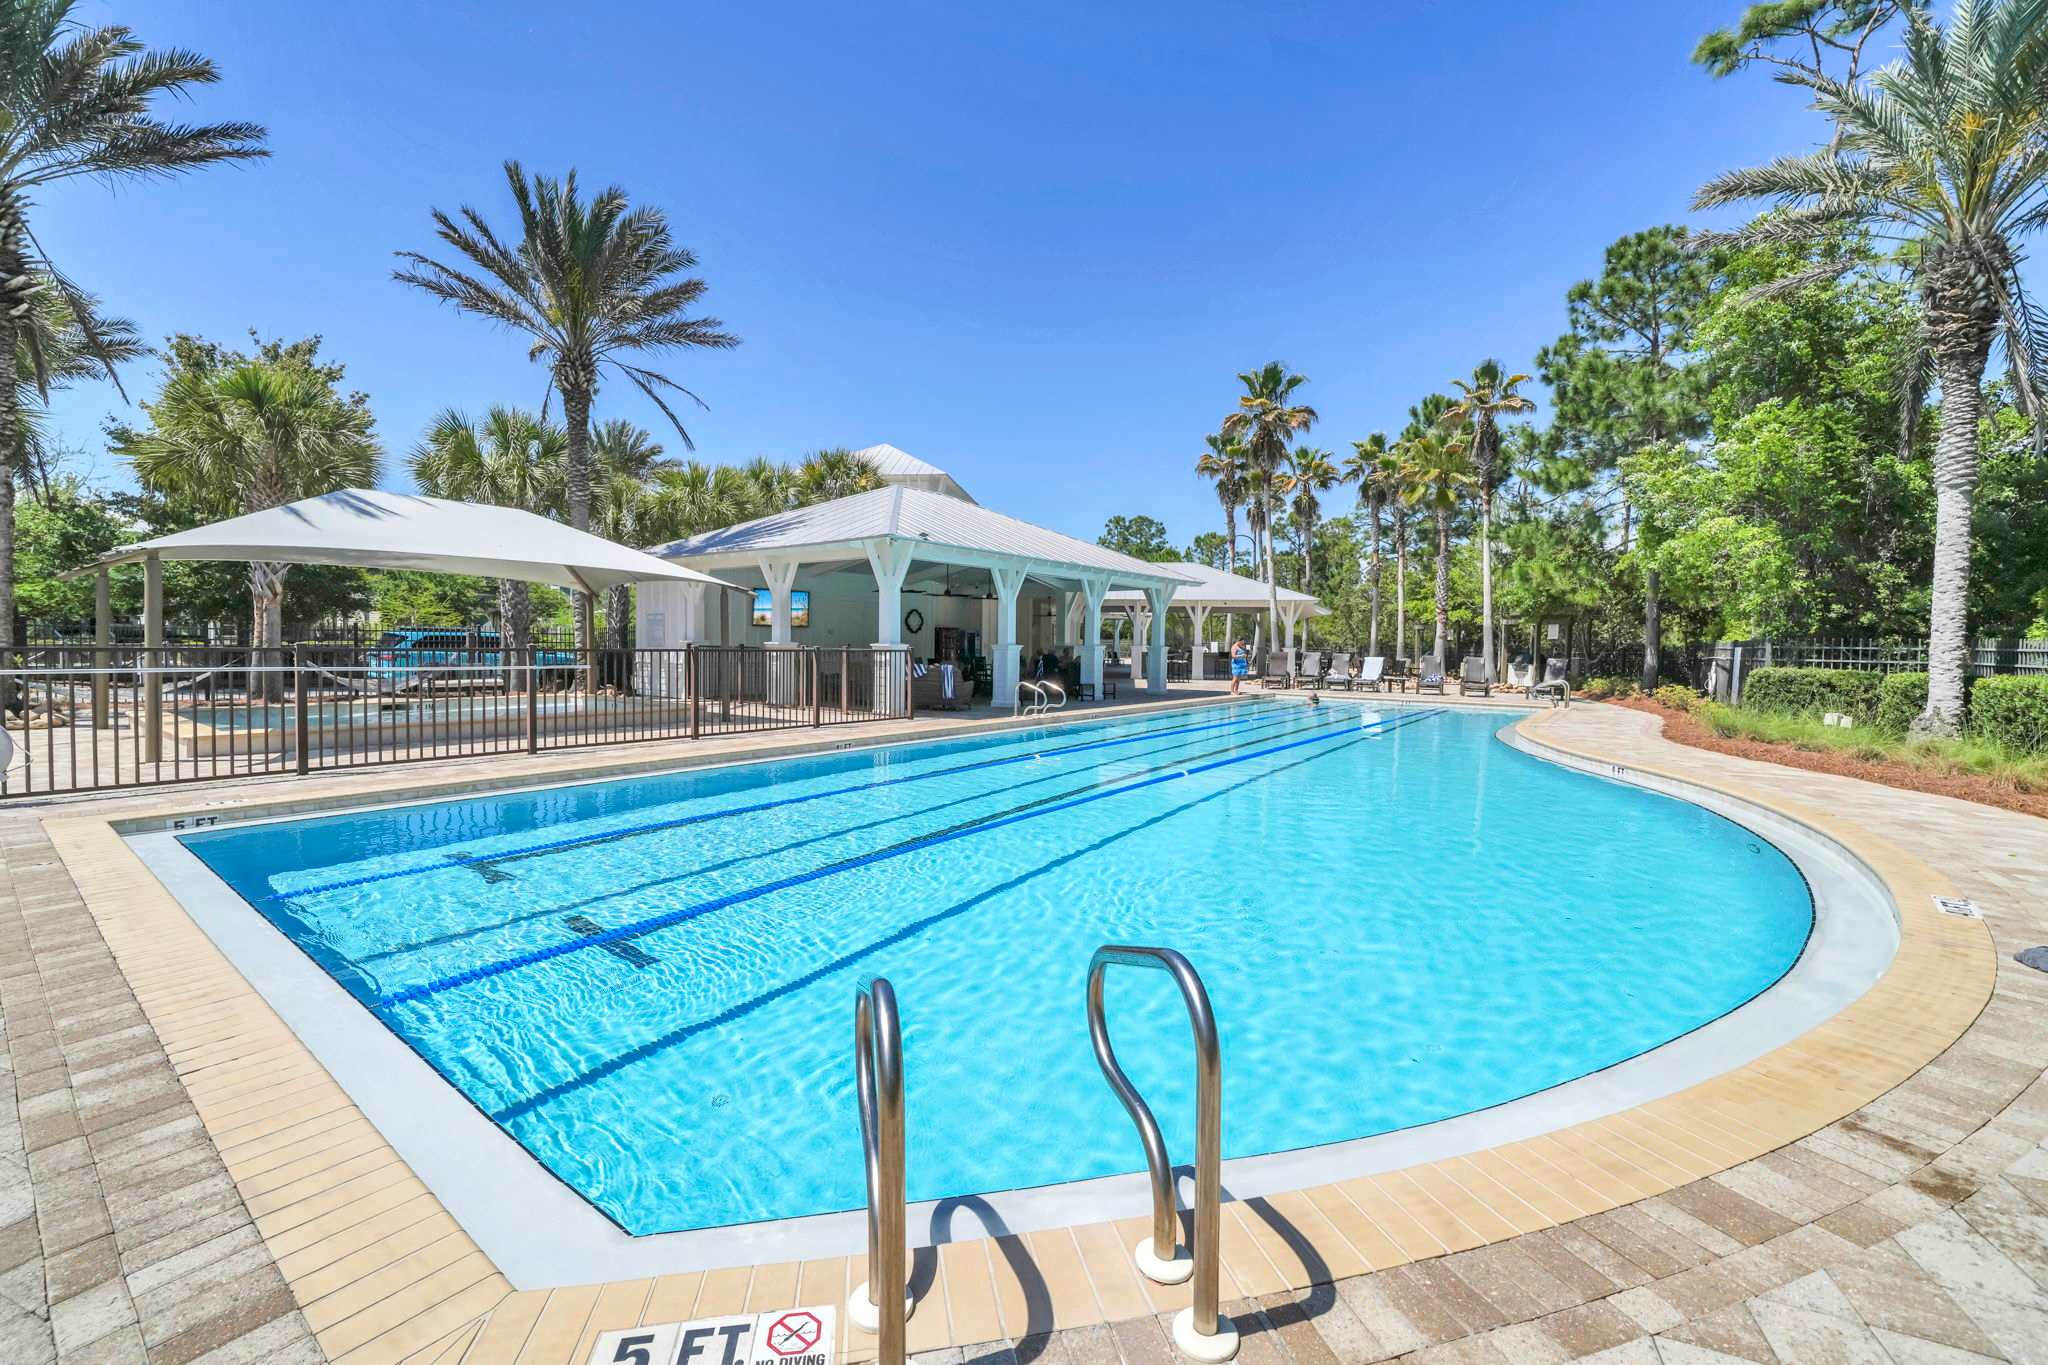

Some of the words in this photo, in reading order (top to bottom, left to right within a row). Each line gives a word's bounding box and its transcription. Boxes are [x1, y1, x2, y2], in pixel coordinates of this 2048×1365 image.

[173, 821, 185, 830] 5
[195, 816, 218, 827] FT
[612, 1334, 656, 1365] 5
[779, 1353, 826, 1365] DIVING
